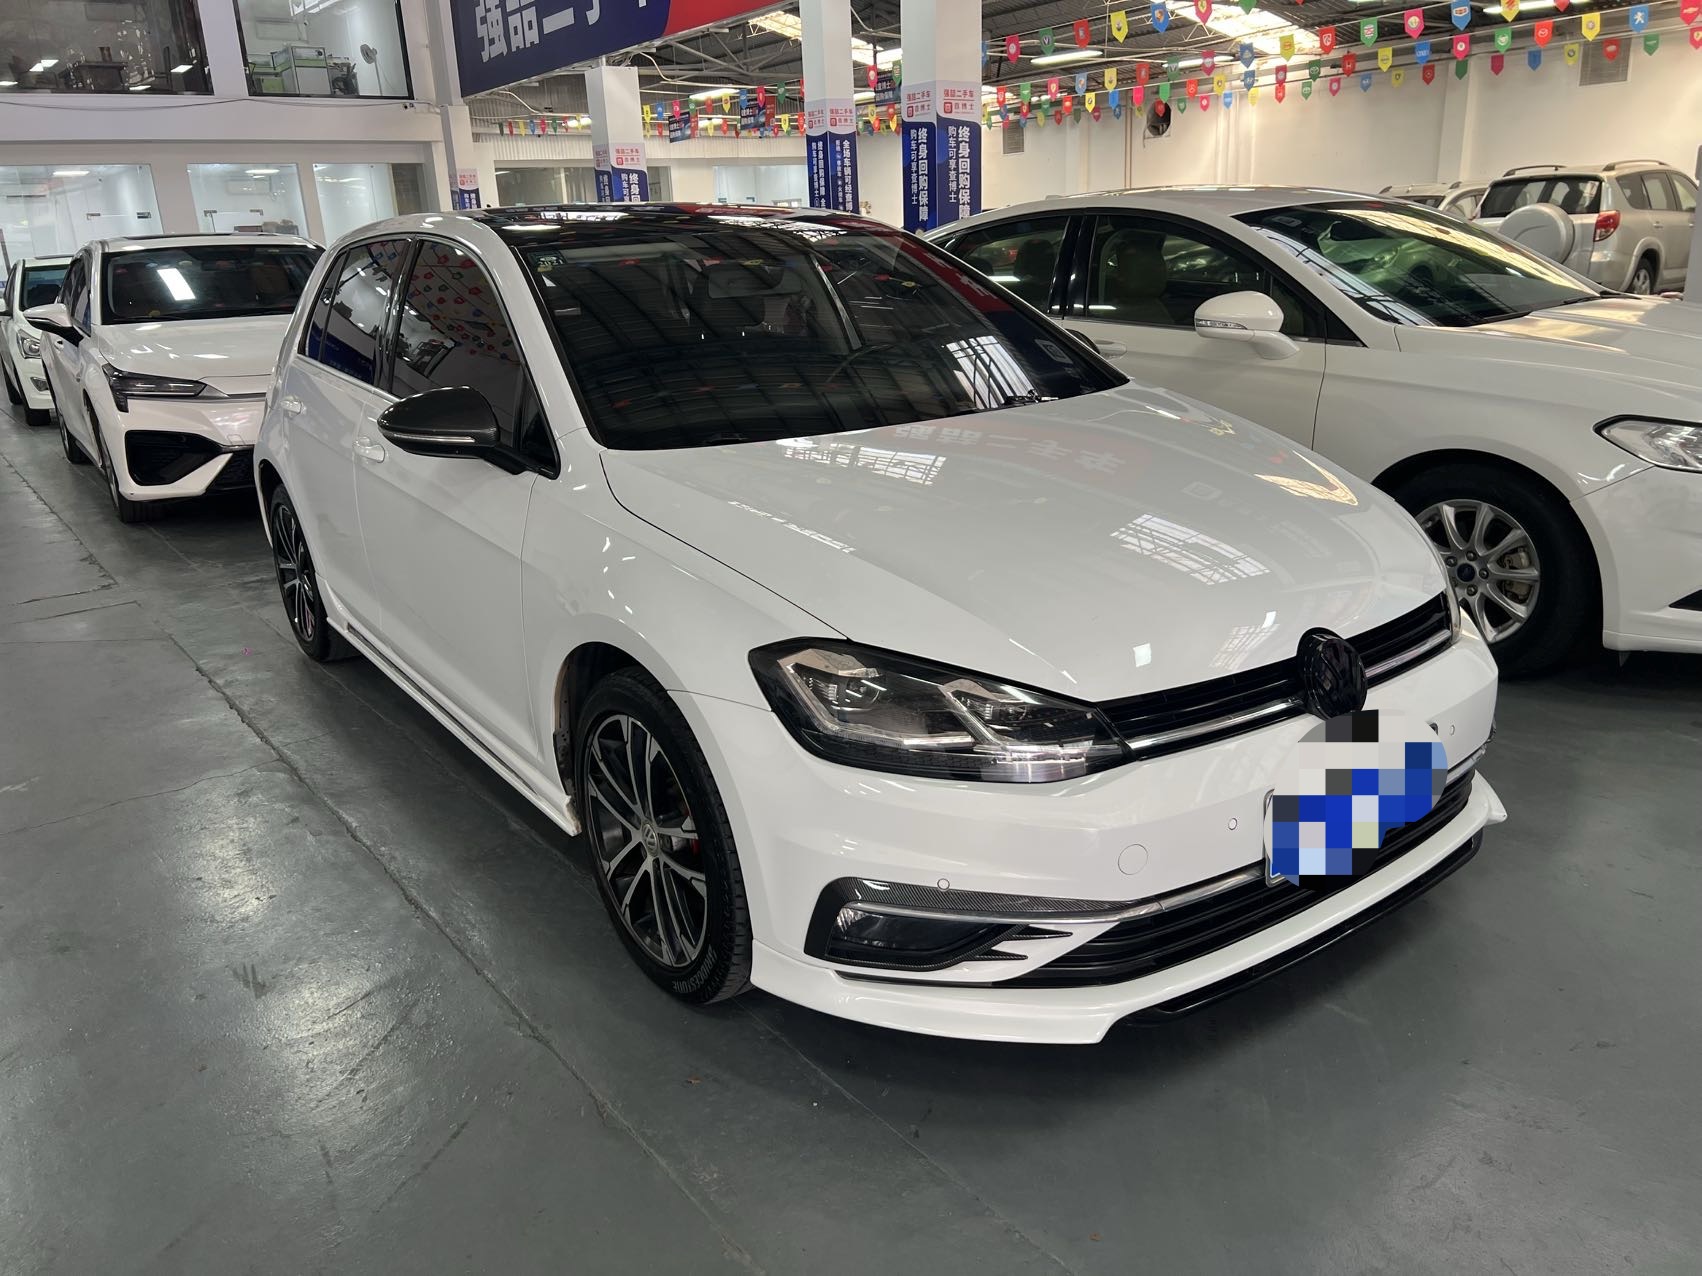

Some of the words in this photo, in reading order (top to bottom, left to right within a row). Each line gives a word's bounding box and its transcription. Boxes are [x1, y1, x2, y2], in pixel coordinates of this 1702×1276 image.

[918, 127, 928, 222] 终身回购保障
[948, 126, 957, 203] 购车可享查博士
[958, 126, 970, 219] 终身回购保障
